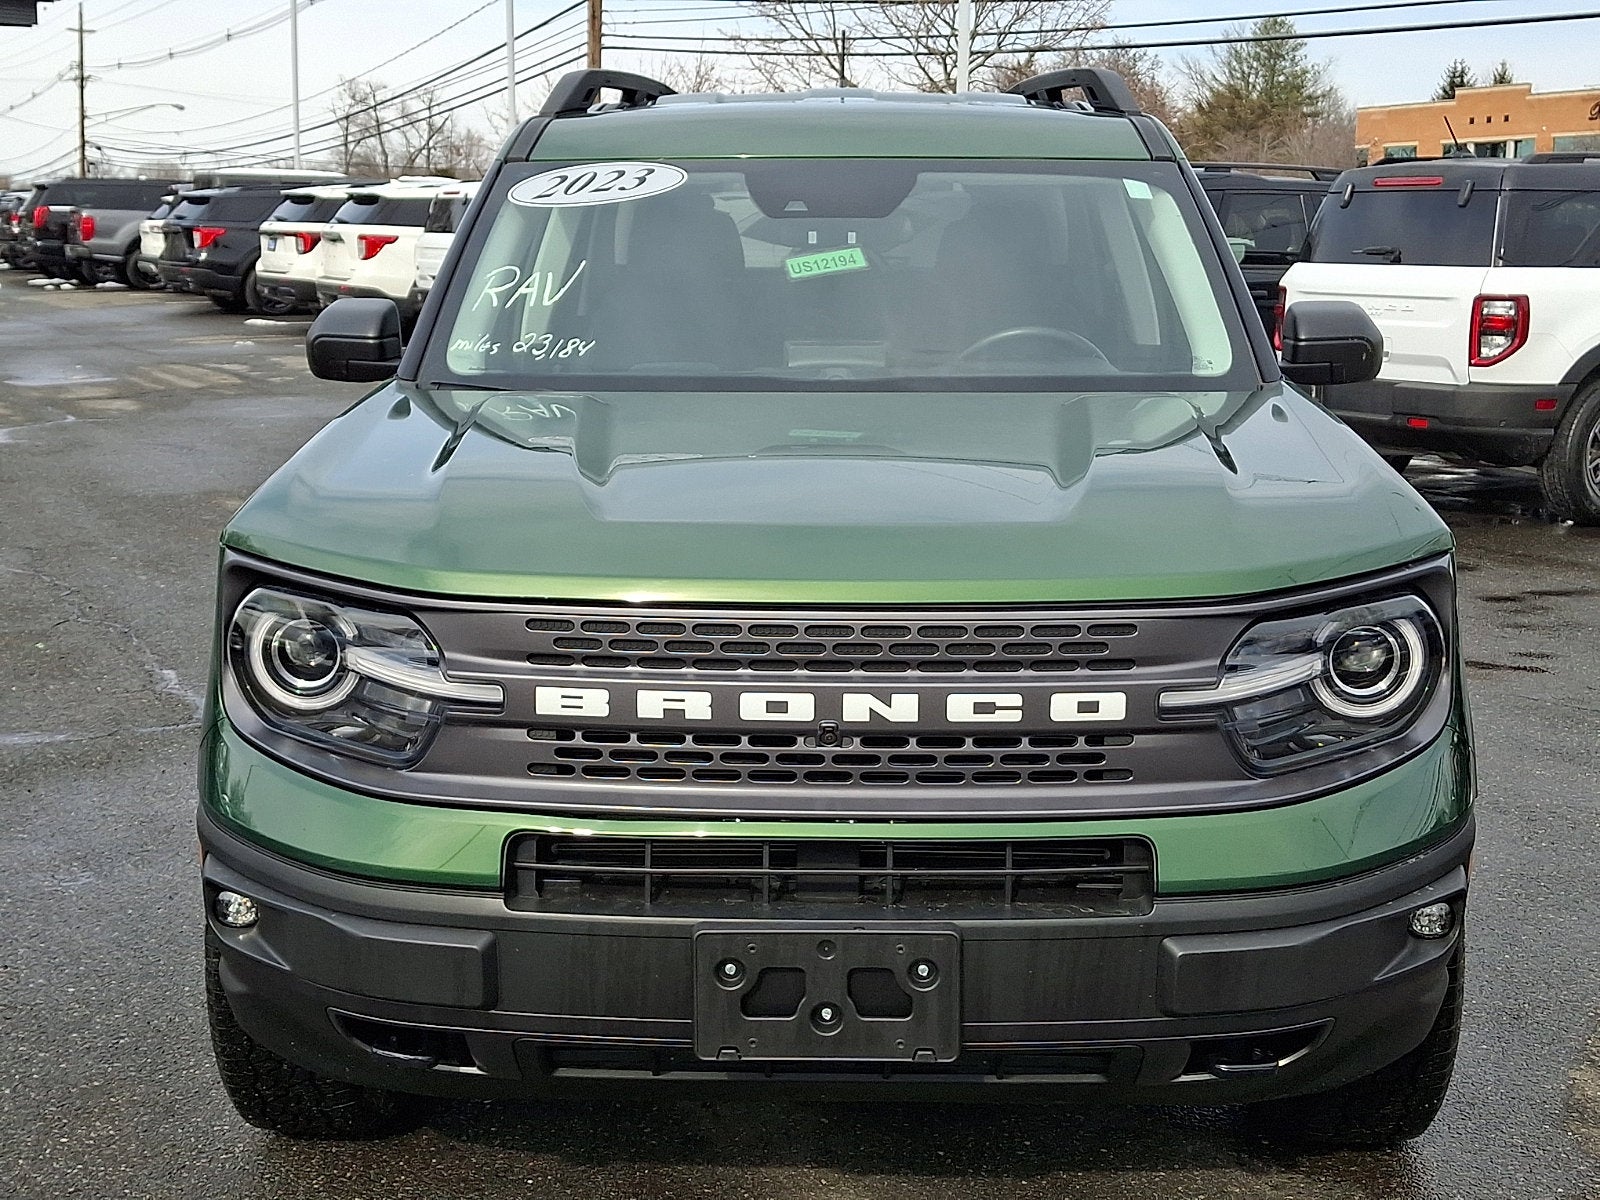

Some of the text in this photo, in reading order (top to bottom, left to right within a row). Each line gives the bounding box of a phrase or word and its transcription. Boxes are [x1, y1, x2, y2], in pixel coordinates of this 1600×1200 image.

[532, 168, 656, 200] 2023
[790, 253, 857, 275] US12194
[472, 260, 587, 312] RAV
[512, 333, 596, 361] 23,184
[535, 686, 1128, 722] BRONCO
